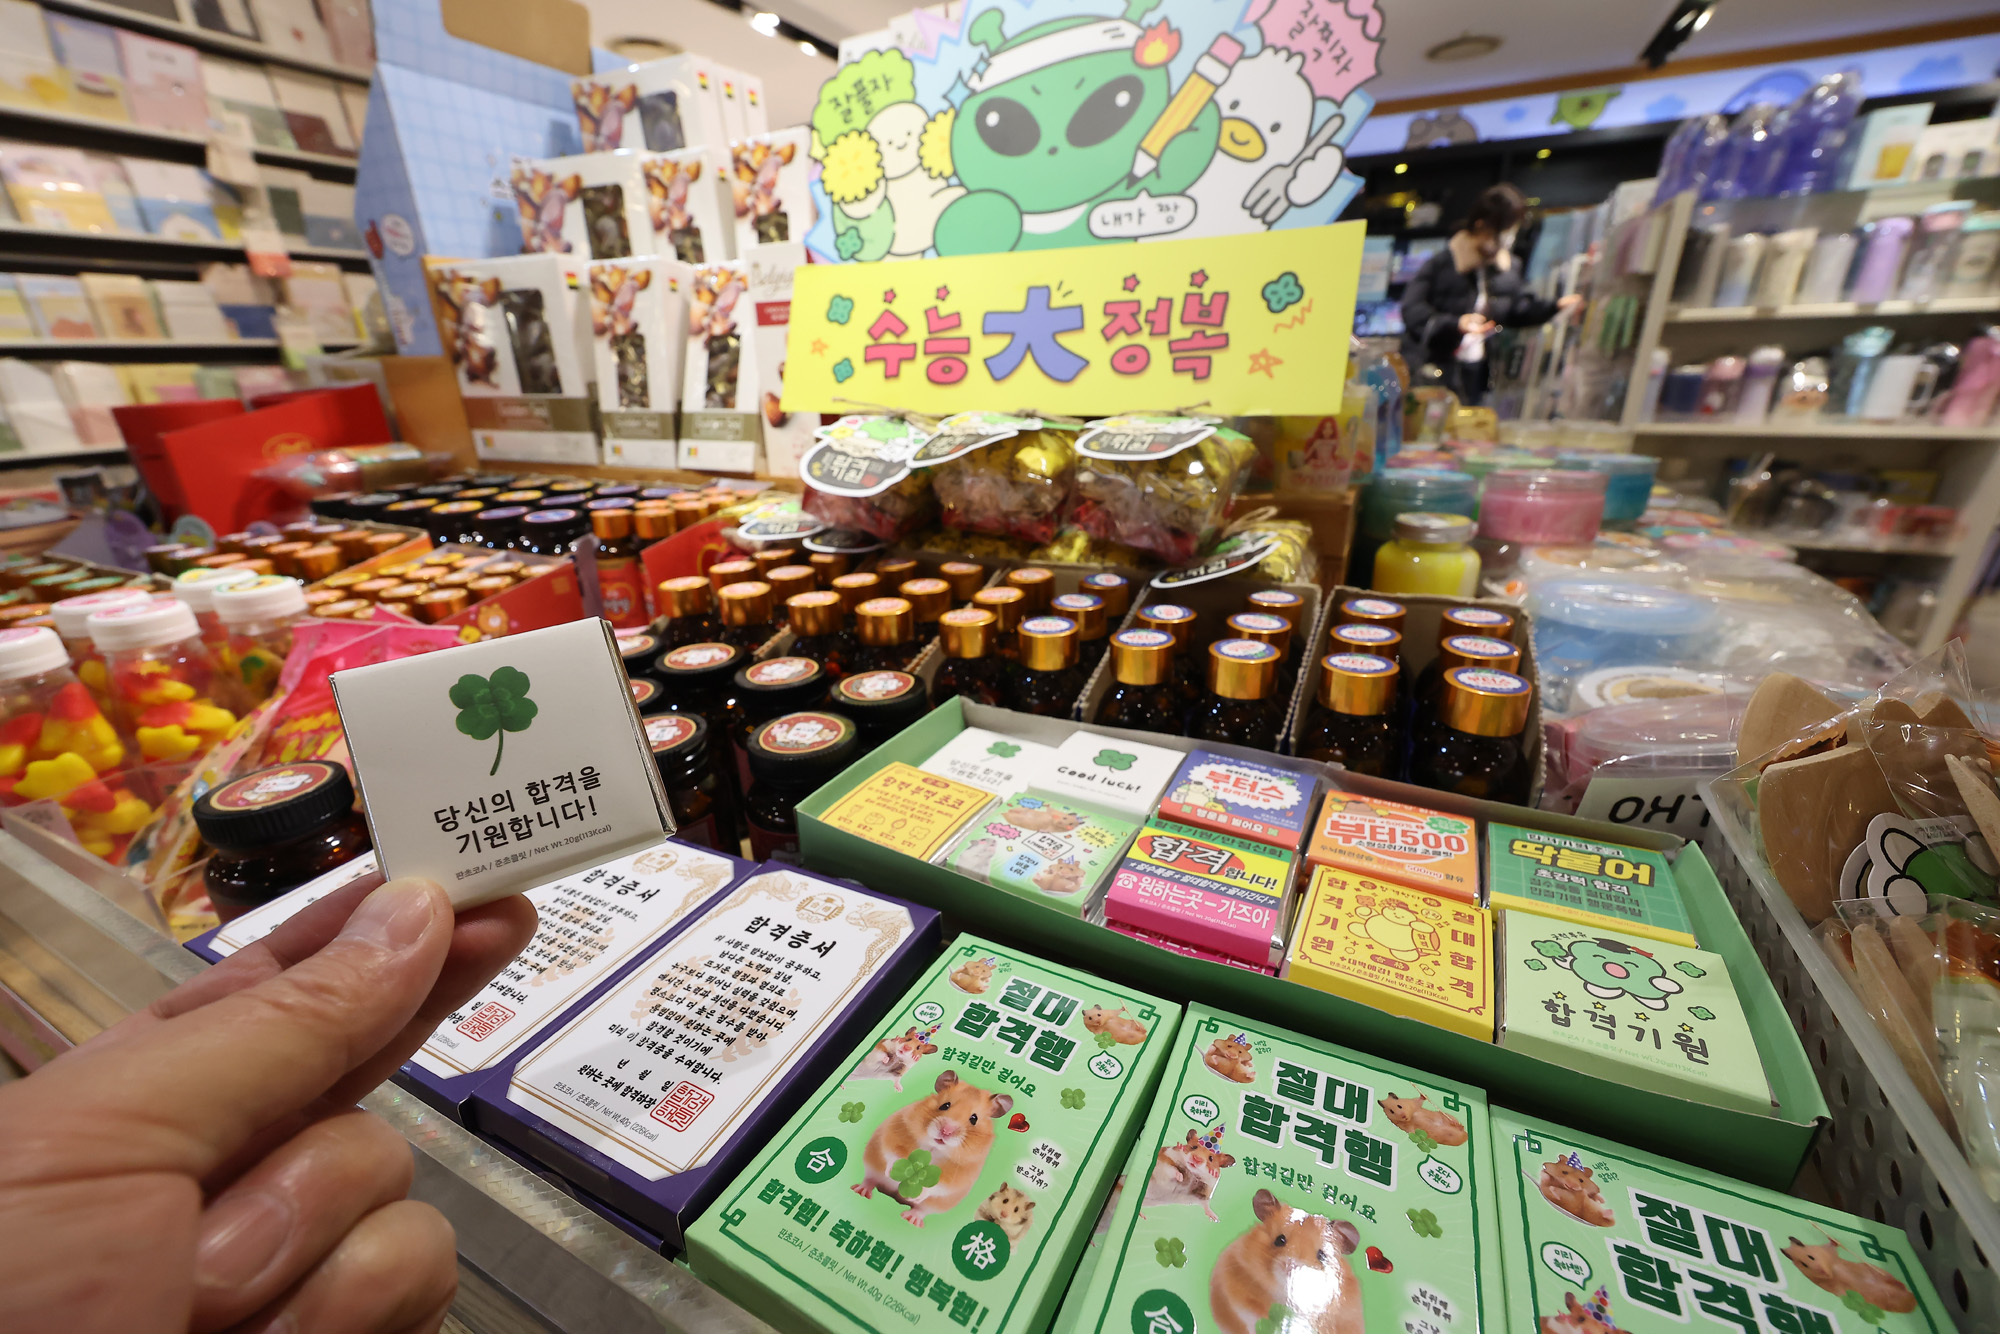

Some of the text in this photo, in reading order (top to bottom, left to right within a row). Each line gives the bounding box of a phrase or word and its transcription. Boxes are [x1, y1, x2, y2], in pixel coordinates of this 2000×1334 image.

[1100, 201, 1182, 228] 내가 짱
[864, 285, 1230, 386] 수능 大 정복
[434, 765, 602, 833] 당신의 합격을
[1057, 765, 1096, 782] Good
[1100, 777, 1142, 793] luck!
[1206, 771, 1284, 800] 부터스
[455, 795, 598, 855] 기원합니다!
[1196, 808, 1229, 824] 행운을
[1231, 816, 1264, 834] 빌어요
[1327, 820, 1466, 852] 부터500
[455, 824, 612, 881] 판초코A 준초콜릿 Net Wt.20g(113Kcal)
[1151, 835, 1278, 890] 합격 합니다!
[1509, 839, 1655, 887] 딱붙어
[583, 868, 661, 904] 합격증서
[1535, 869, 1631, 896] 초강력 합격
[1311, 877, 1349, 954] 합격기원
[745, 916, 836, 958] 합격증서
[1449, 910, 1477, 999] 절대합격
[704, 960, 785, 996] 뜨거운 열정과 열의로
[719, 951, 792, 984] 남다른 노력과 집념,
[726, 939, 749, 951] 사람은
[750, 948, 784, 964] 밤낮없이
[785, 960, 820, 981] 공부하고,
[672, 963, 705, 979] 누구보다
[706, 976, 732, 990] 뛰어난
[732, 987, 758, 1002] 실력을
[999, 978, 1078, 1027] 절대
[1385, 978, 1397, 987] Net
[683, 984, 711, 998] 노력과
[711, 995, 738, 1010] 최선을
[739, 1007, 785, 1032] 다했습니다.
[686, 1002, 698, 1010] 더
[696, 1006, 716, 1018] 높은
[717, 1014, 746, 1032] 점수를
[746, 1028, 768, 1042] 받아
[646, 1021, 713, 1056] 합격할 것이기에
[684, 1020, 711, 1036] 원하는
[712, 1032, 736, 1046] 곳에
[954, 1002, 1077, 1072] 합격햄
[1541, 999, 1709, 1066] 합격기원
[609, 1024, 722, 1084] 미리 이 합격증을 수여합니다.
[942, 1047, 1036, 1097] 합격길만 걸어요
[578, 1065, 657, 1109] 원하는 곳에 합격하장
[618, 1059, 674, 1092] 년 월 일
[1276, 1059, 1369, 1125] 절대
[601, 1107, 613, 1116] Net
[630, 1122, 659, 1141] (226Kcal)
[1190, 1106, 1211, 1117] 축하햄!
[807, 1148, 835, 1172] 合
[1242, 1093, 1393, 1187] 합격햄
[1029, 1165, 1044, 1176] 그냥
[1242, 1156, 1377, 1223] 합격길만 걸어요
[1427, 1168, 1450, 1188] 주웠따
[1436, 1166, 1451, 1178] 오다
[756, 1178, 990, 1334] 합격햄! 축하햄! 행복햄!
[962, 1232, 996, 1269] 格
[1554, 1249, 1574, 1261] 미리
[1635, 1192, 1779, 1283] 절대
[778, 1228, 920, 1325] 판초코A 준초콜릿 Net Wt.40g (226Kcal)
[1553, 1257, 1585, 1277] 축하햄!
